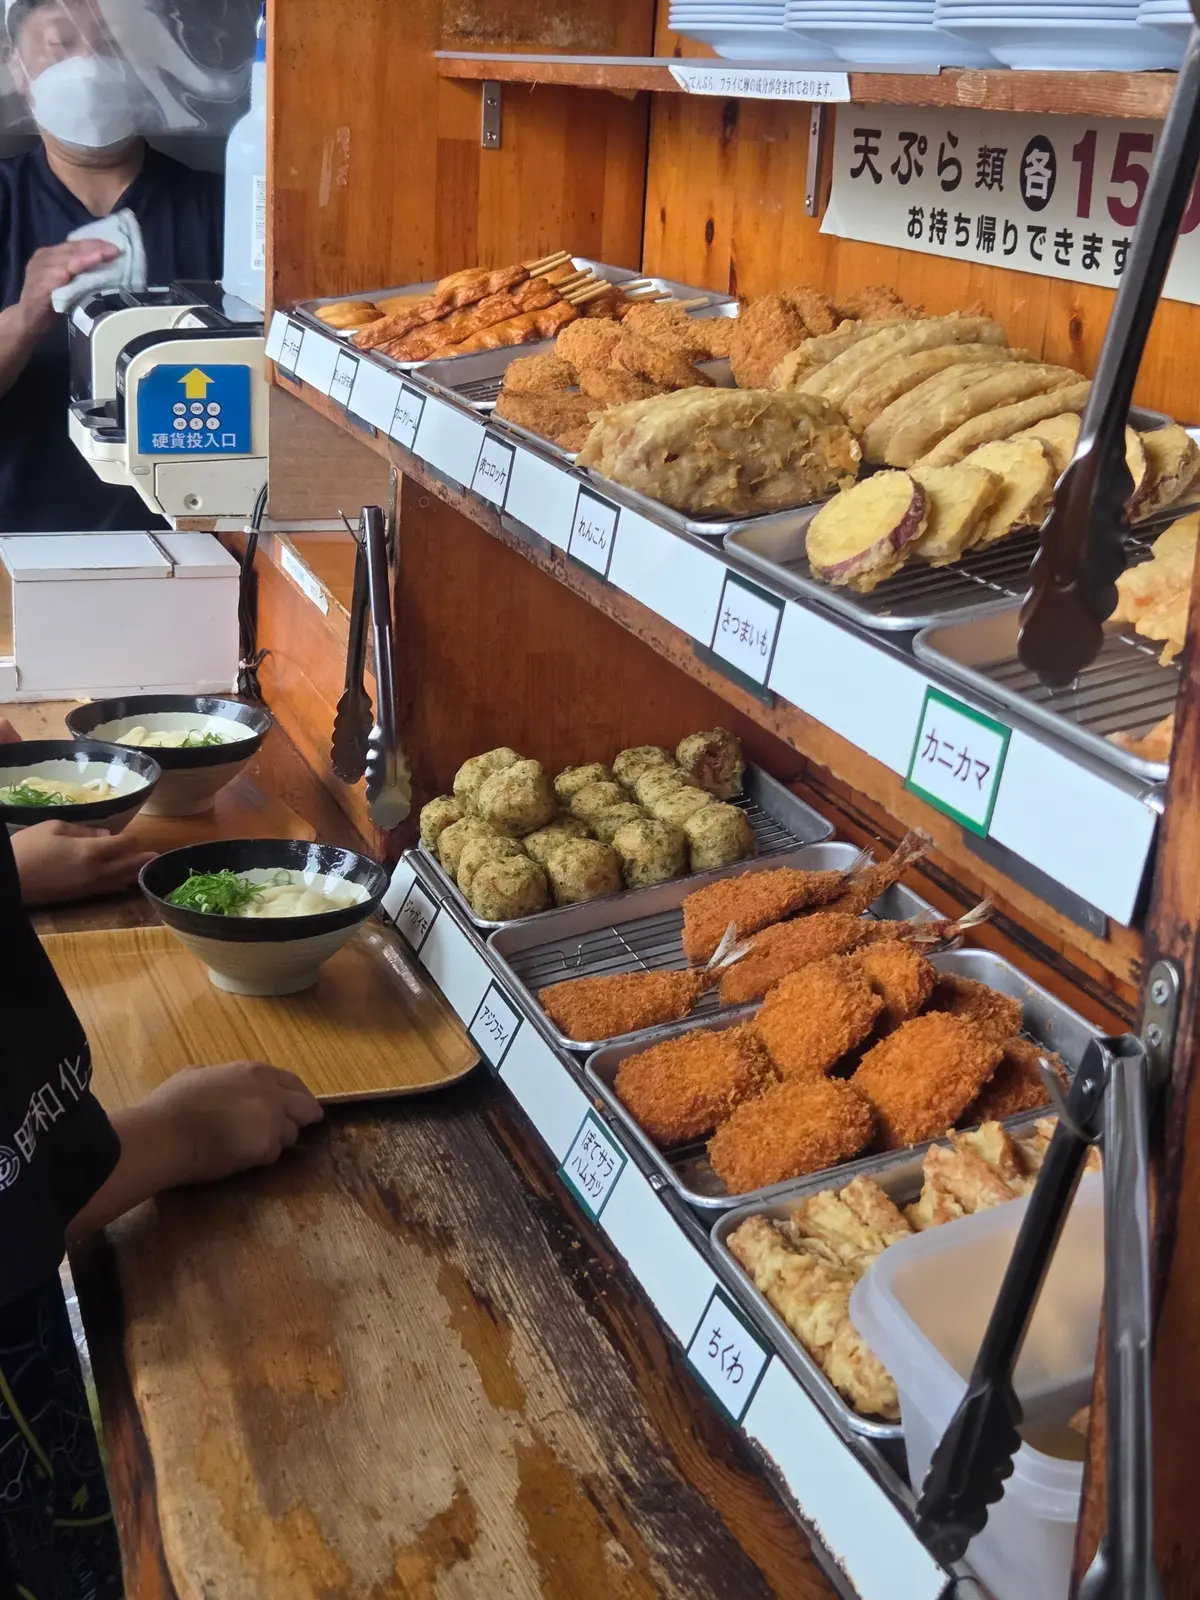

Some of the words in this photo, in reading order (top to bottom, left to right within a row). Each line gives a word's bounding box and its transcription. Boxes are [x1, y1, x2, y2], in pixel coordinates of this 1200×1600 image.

[850, 127, 1008, 192] 天ぷら類
[1022, 143, 1054, 206] 各
[1072, 129, 1200, 236] 15
[152, 432, 236, 449] 硬貨投入口
[577, 517, 607, 550] れんこん
[720, 607, 769, 657] さつまいも
[920, 727, 991, 791] カニカマ
[403, 899, 428, 935] ジャガイモ
[480, 1005, 509, 1048] アジフライ
[571, 1156, 604, 1198] ハムカツ
[707, 1326, 744, 1384] ちくわ
